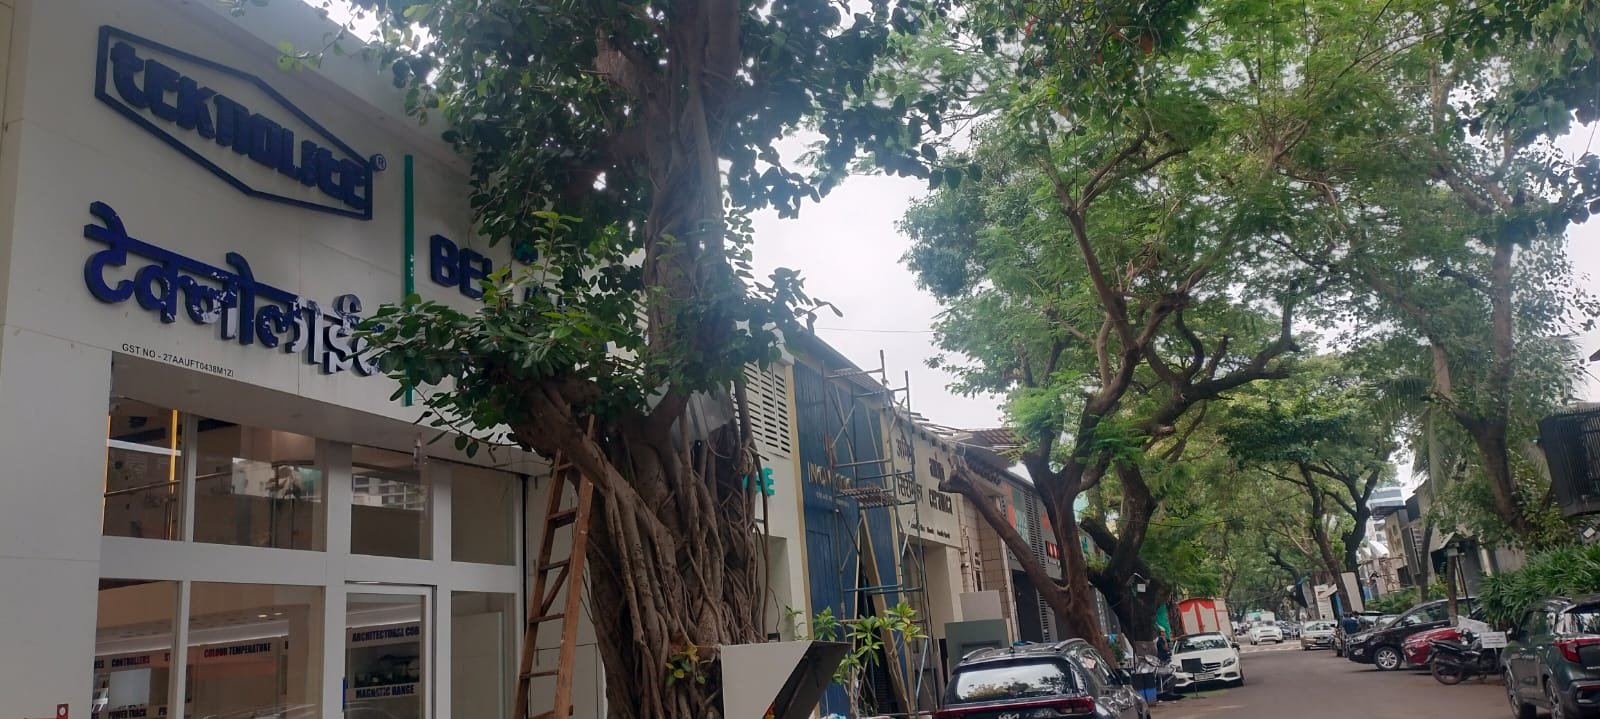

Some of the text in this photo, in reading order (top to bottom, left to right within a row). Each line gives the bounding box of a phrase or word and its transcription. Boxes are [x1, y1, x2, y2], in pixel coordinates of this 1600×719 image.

[122, 343, 141, 355] GST
[143, 349, 156, 358] NO
[204, 643, 271, 658] COLOUR TEMPERATURE
[112, 655, 150, 667] CONTROLLERS
[356, 684, 415, 698] MAGNETIC RANGE
[109, 710, 128, 719] POWER
[129, 708, 147, 717] TRACK
